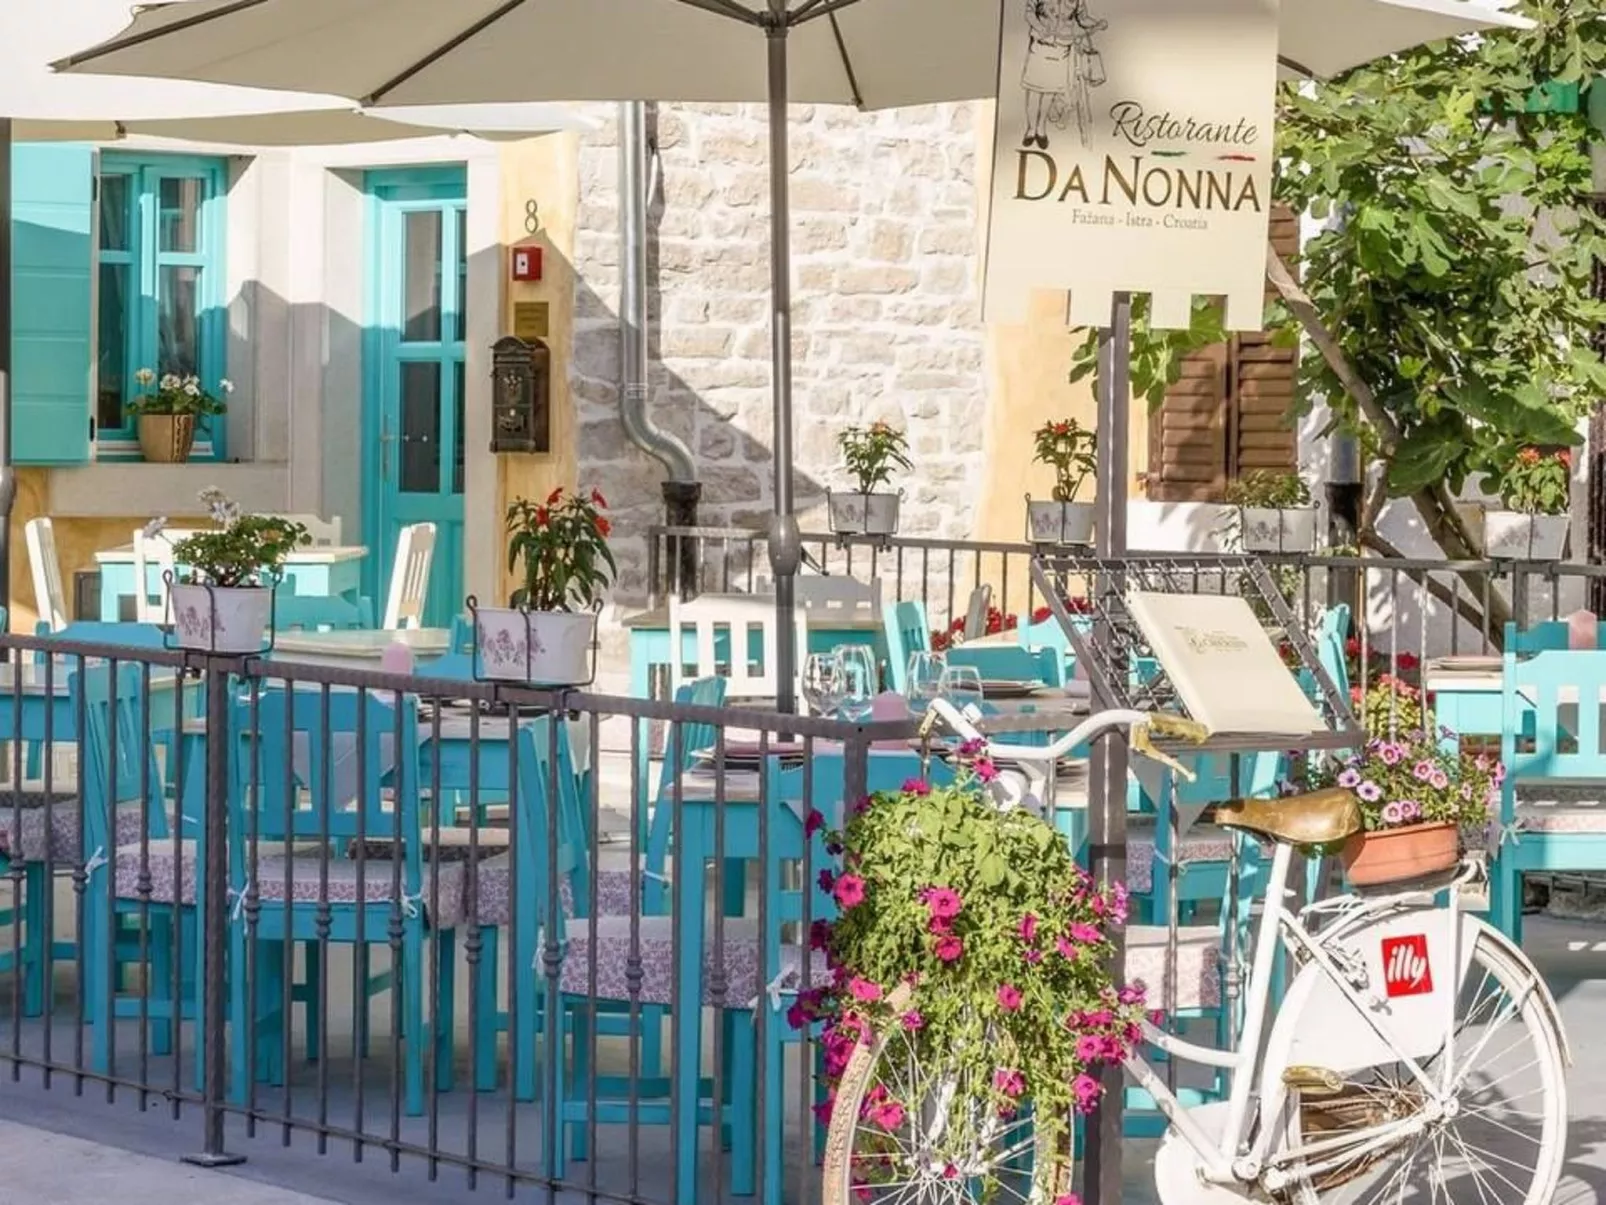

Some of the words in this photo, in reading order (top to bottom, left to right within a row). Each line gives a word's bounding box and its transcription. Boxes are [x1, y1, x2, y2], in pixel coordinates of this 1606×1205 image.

[1109, 101, 1258, 147] Ristorante
[1013, 149, 1090, 203] DA
[1098, 154, 1262, 213] NONNA
[525, 199, 538, 233] 8
[1126, 212, 1153, 228] Istra
[1163, 214, 1208, 230] Croatia
[1387, 943, 1427, 990] illy
